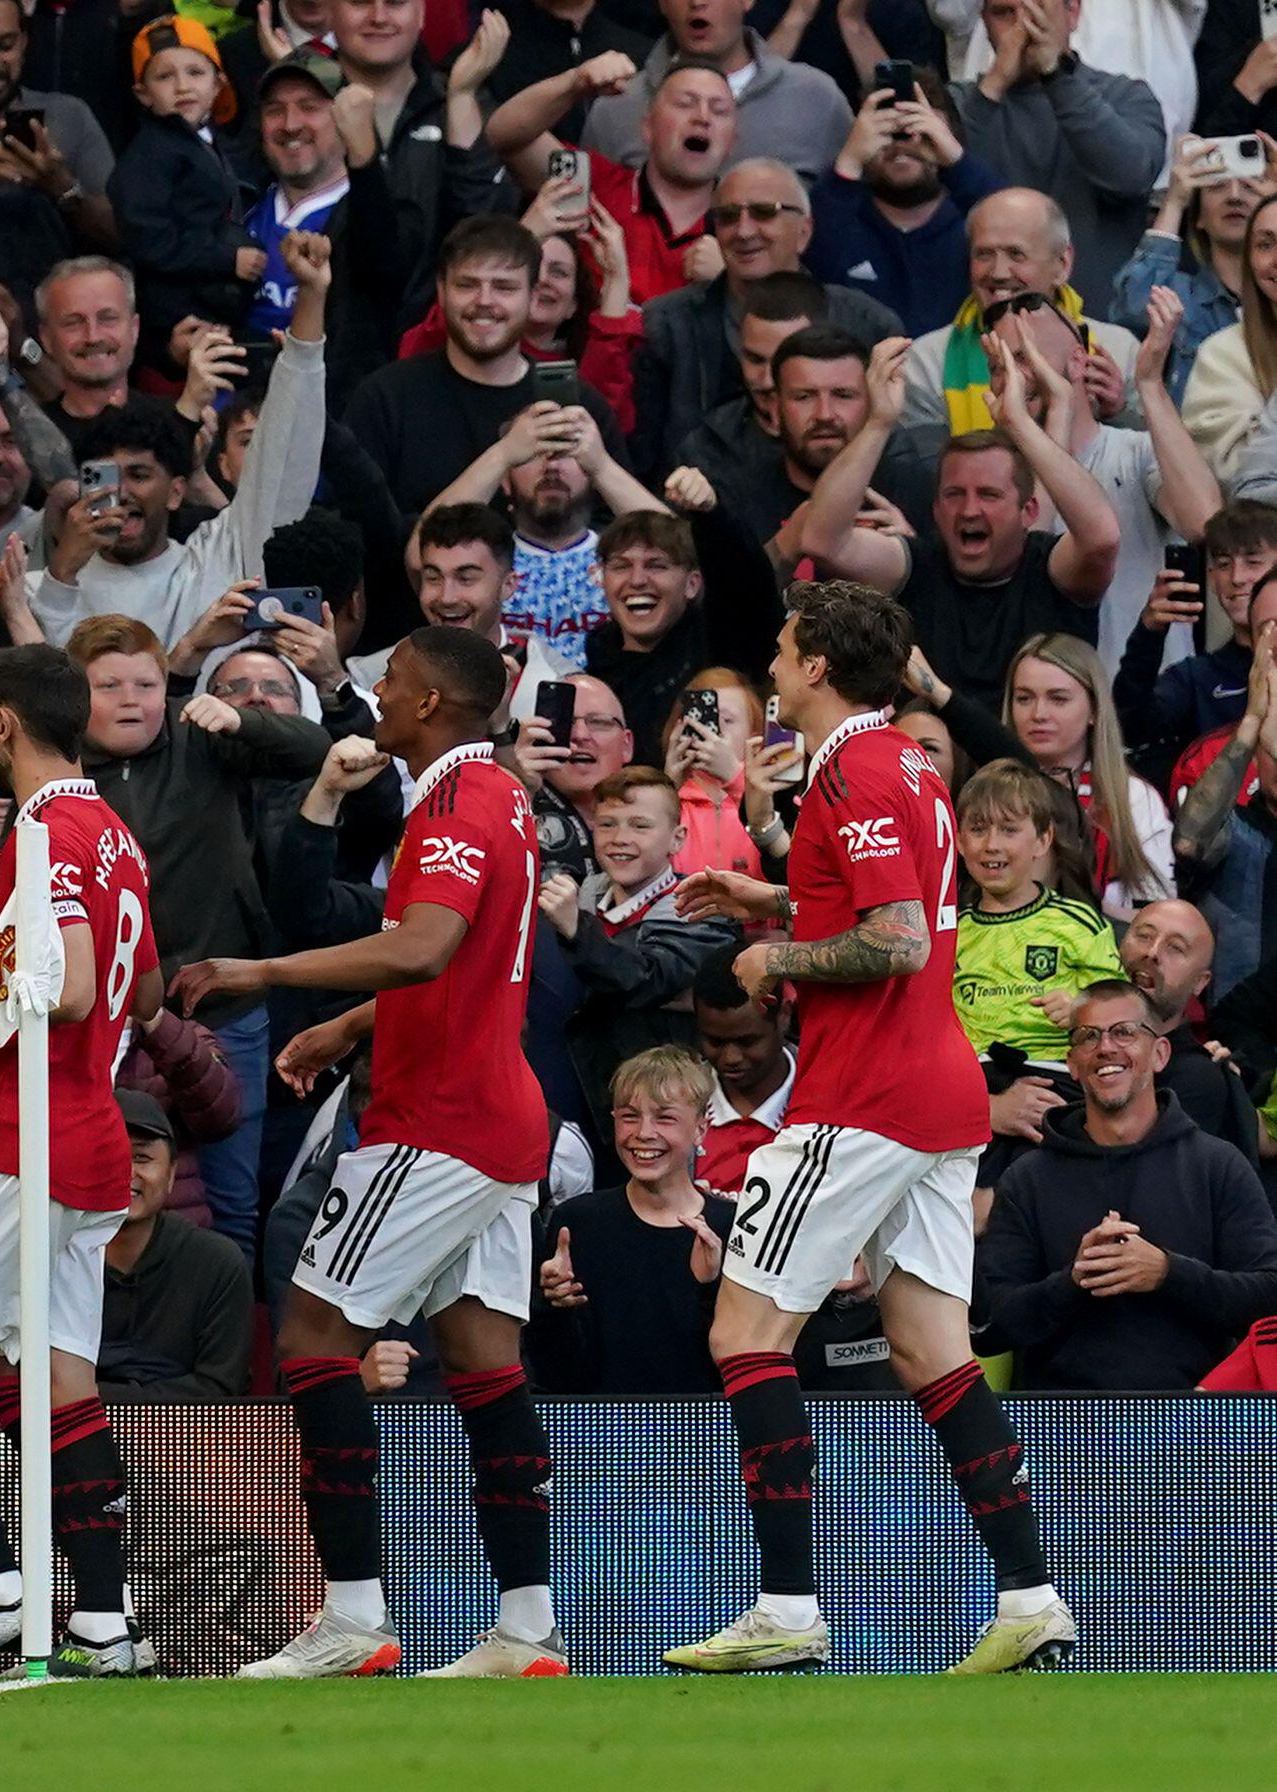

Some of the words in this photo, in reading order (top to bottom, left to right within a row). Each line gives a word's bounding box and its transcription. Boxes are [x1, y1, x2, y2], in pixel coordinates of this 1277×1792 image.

[419, 836, 486, 879] DXC
[420, 862, 479, 886] TECHNOLOGY
[934, 797, 958, 933] 2
[107, 887, 143, 1021] 8
[311, 1186, 349, 1241] 9
[735, 1175, 771, 1237] 2
